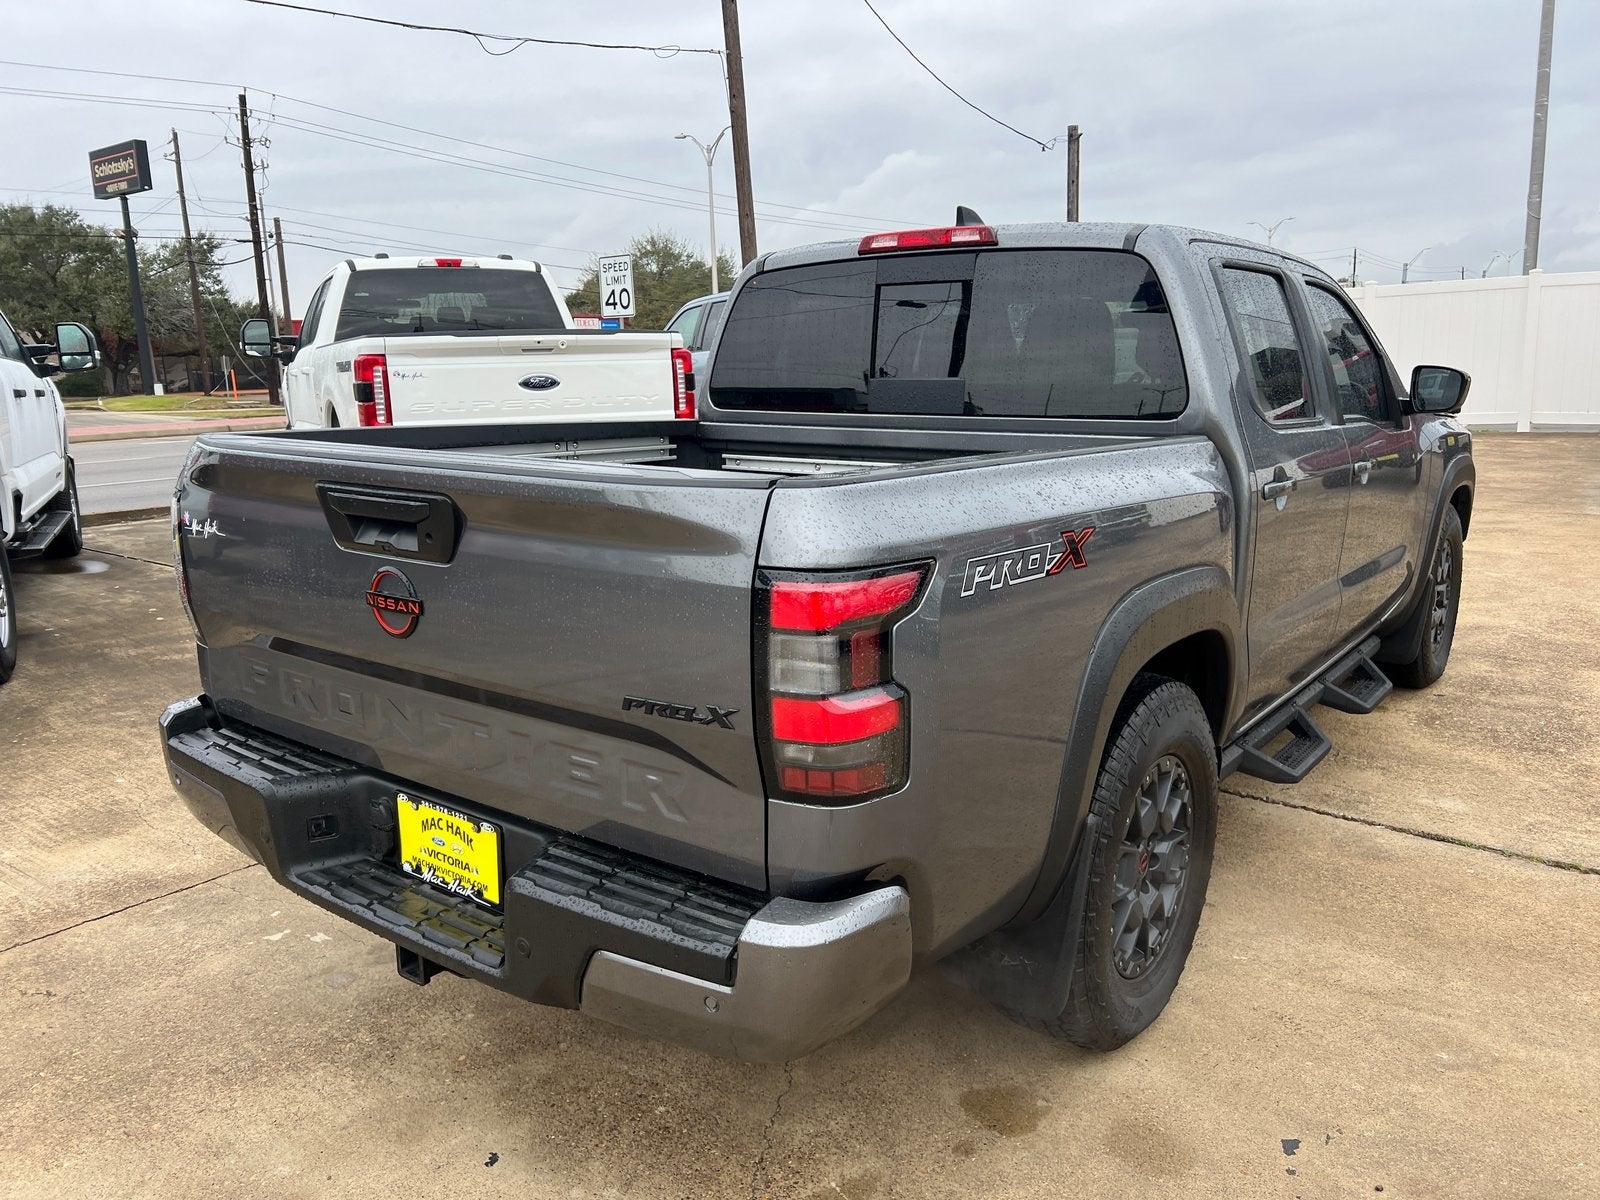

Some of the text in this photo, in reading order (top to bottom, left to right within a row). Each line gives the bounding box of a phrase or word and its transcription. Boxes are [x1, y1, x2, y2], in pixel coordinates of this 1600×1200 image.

[94, 157, 134, 178] Schlotzsky's
[602, 261, 629, 273] SPEED
[605, 275, 627, 286] LIMIT
[605, 287, 631, 310] 40
[409, 394, 661, 414] SUPER DUTY
[366, 593, 420, 614] NISSAN
[241, 659, 691, 826] FRONTIER
[421, 817, 475, 852] MAC HAIK
[426, 847, 471, 873] VICTORIA
[421, 867, 482, 900] Mac Haik
